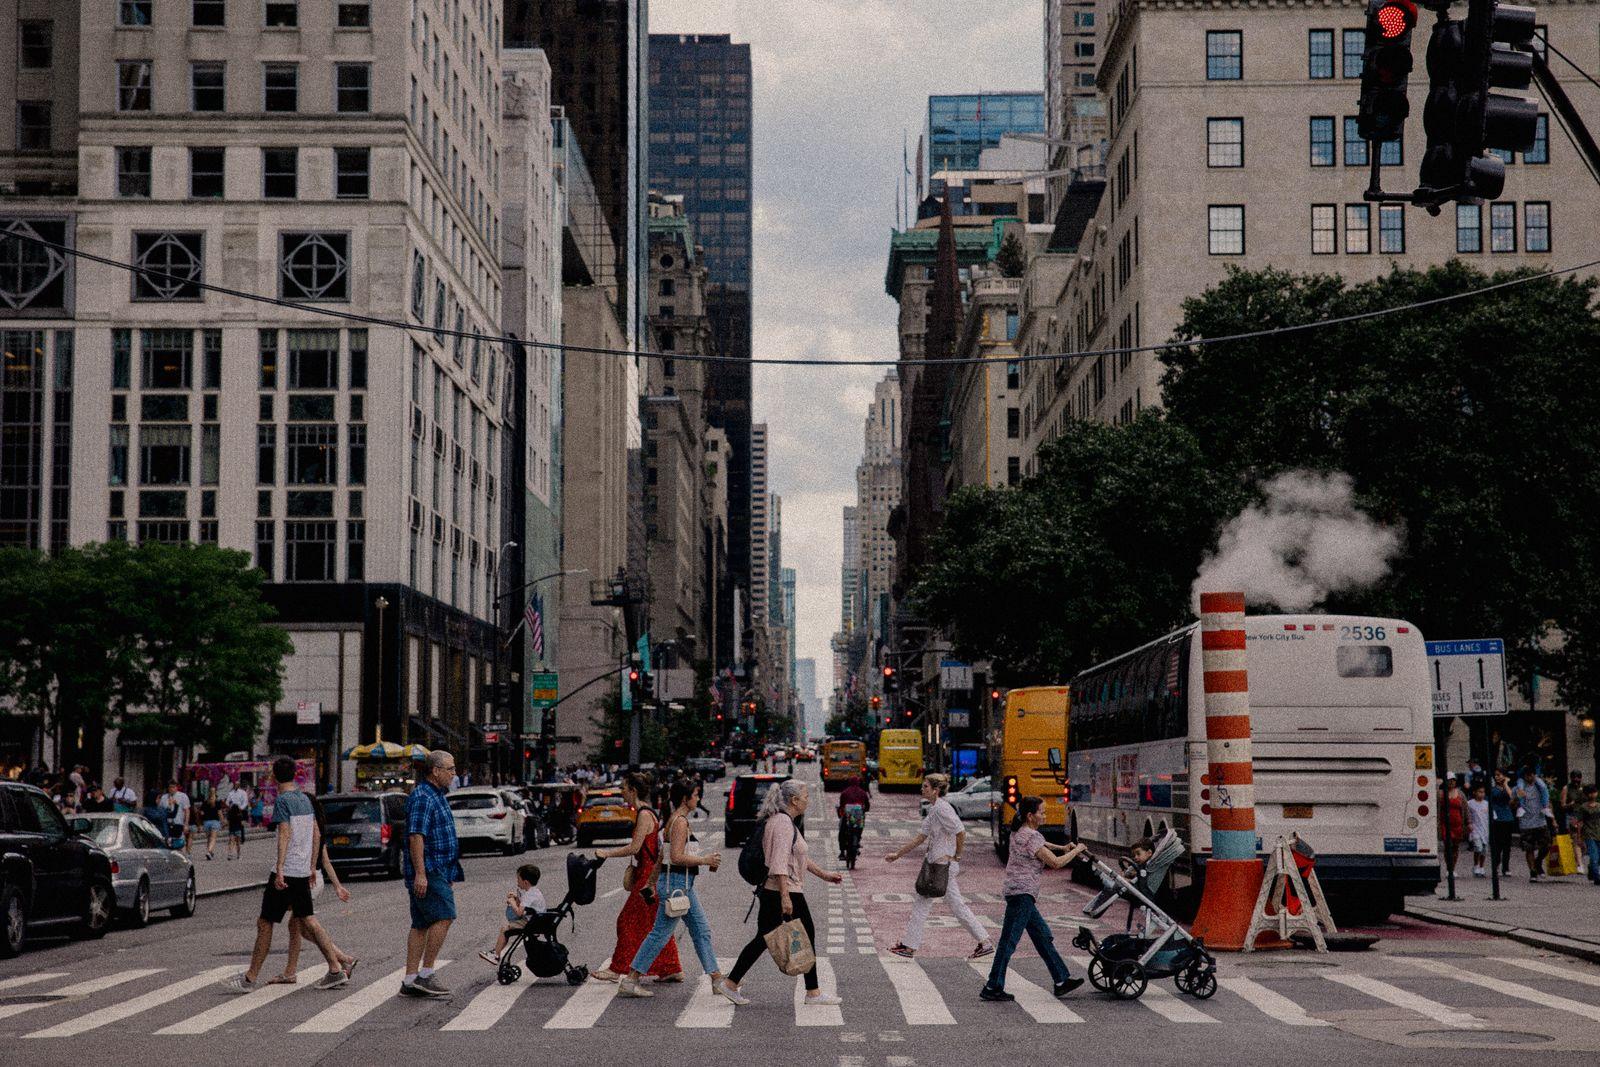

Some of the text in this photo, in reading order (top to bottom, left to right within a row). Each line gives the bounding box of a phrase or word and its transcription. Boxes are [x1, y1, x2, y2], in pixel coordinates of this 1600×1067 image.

[1276, 634, 1290, 642] City
[1340, 626, 1386, 641] 2536
[1435, 643, 1481, 654] BUS LANES
[1472, 691, 1494, 700] BUSES
[1474, 702, 1493, 711] ONLY
